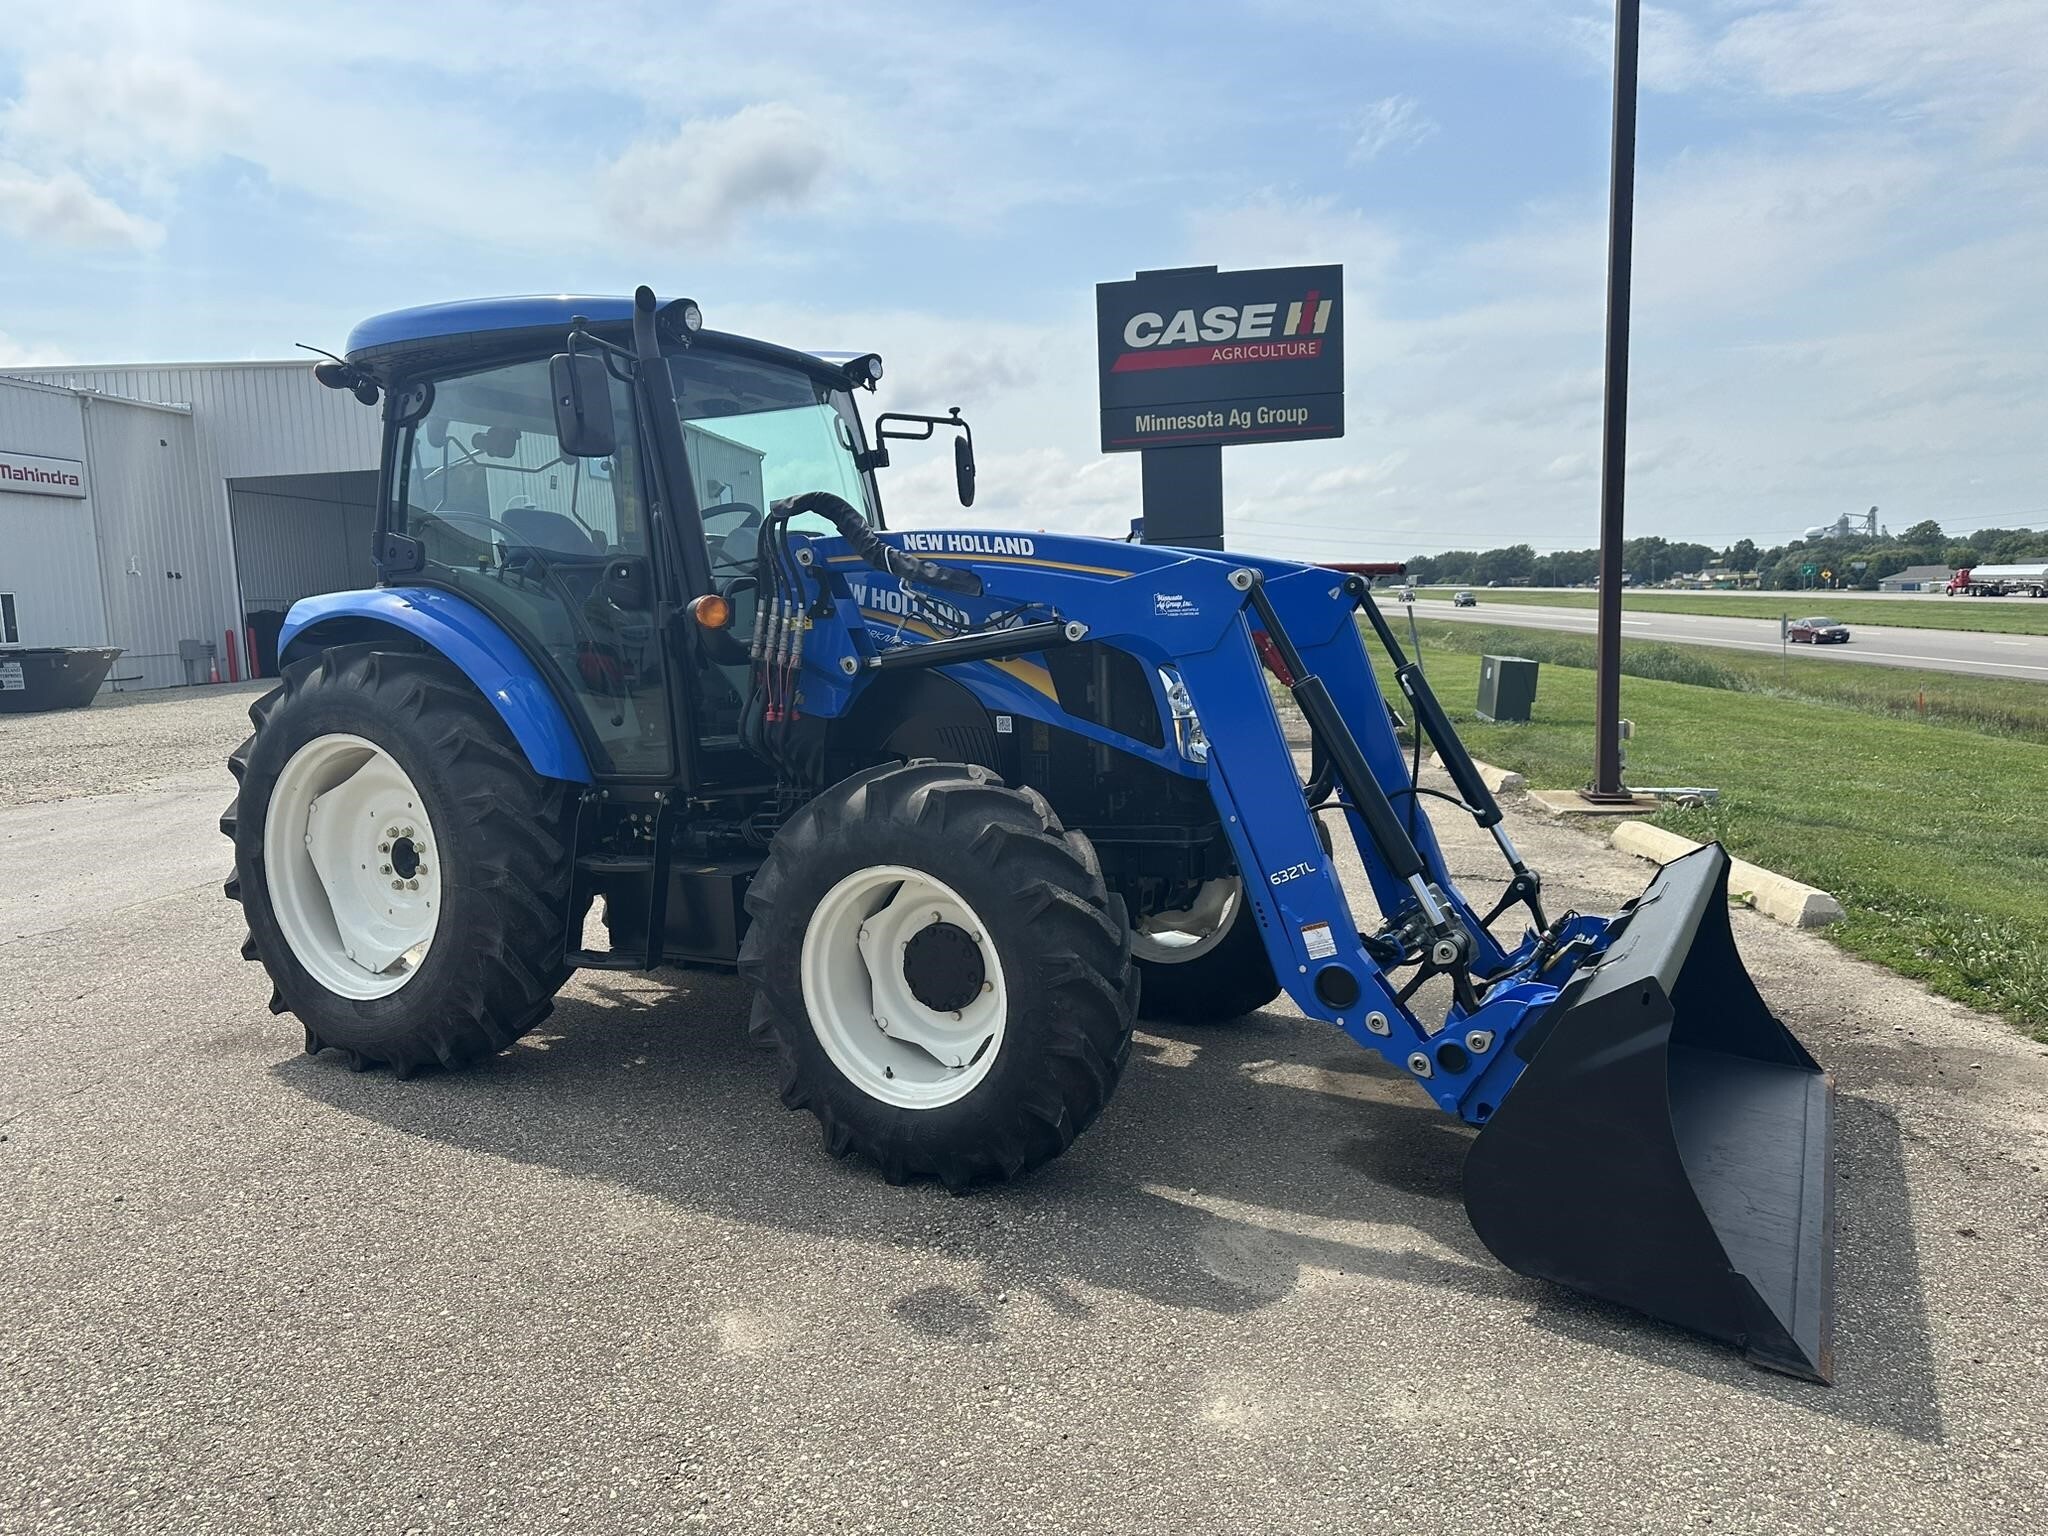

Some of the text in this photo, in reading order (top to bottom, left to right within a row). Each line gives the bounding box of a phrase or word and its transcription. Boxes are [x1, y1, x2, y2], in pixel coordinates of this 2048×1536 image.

[1123, 303, 1278, 348] CASE
[1211, 341, 1317, 361] AGRICULTURE
[1135, 406, 1309, 432] Minnesota Ag Group
[0, 463, 79, 486] Mahindra
[903, 534, 1035, 556] NEW HOLLAND
[1270, 861, 1316, 885] 632TL
